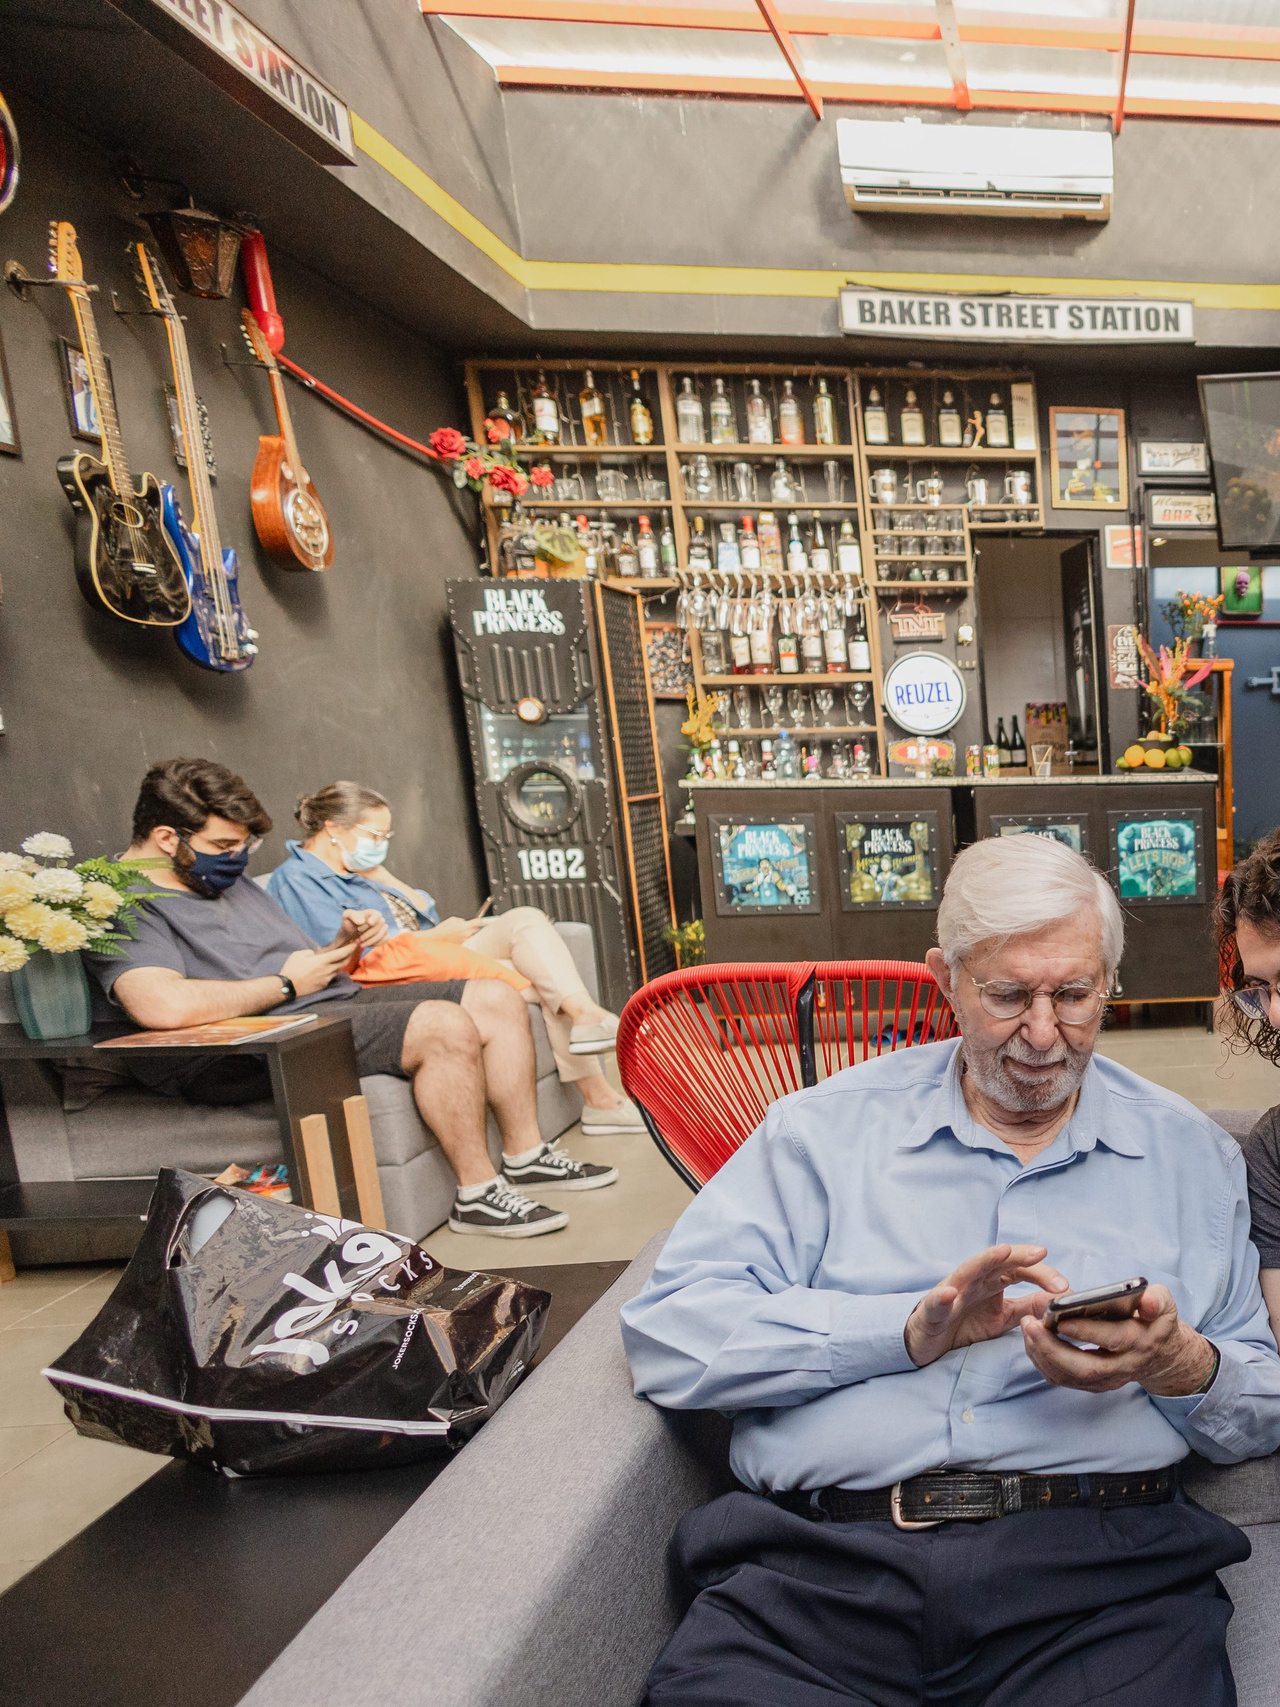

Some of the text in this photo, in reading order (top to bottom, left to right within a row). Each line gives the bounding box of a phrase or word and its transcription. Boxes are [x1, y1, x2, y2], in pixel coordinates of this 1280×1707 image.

[171, 0, 341, 141] ET STATION
[859, 300, 1181, 333] BAKER STREET STATION
[483, 588, 549, 613] BLACK
[890, 612, 946, 632] TNT
[895, 682, 953, 706] REUZEL
[744, 830, 780, 845] BLACK
[871, 828, 904, 841] BLACK
[1141, 826, 1171, 840] BLACK
[517, 848, 587, 881] 1882
[1129, 850, 1187, 871] LET'S HOP
